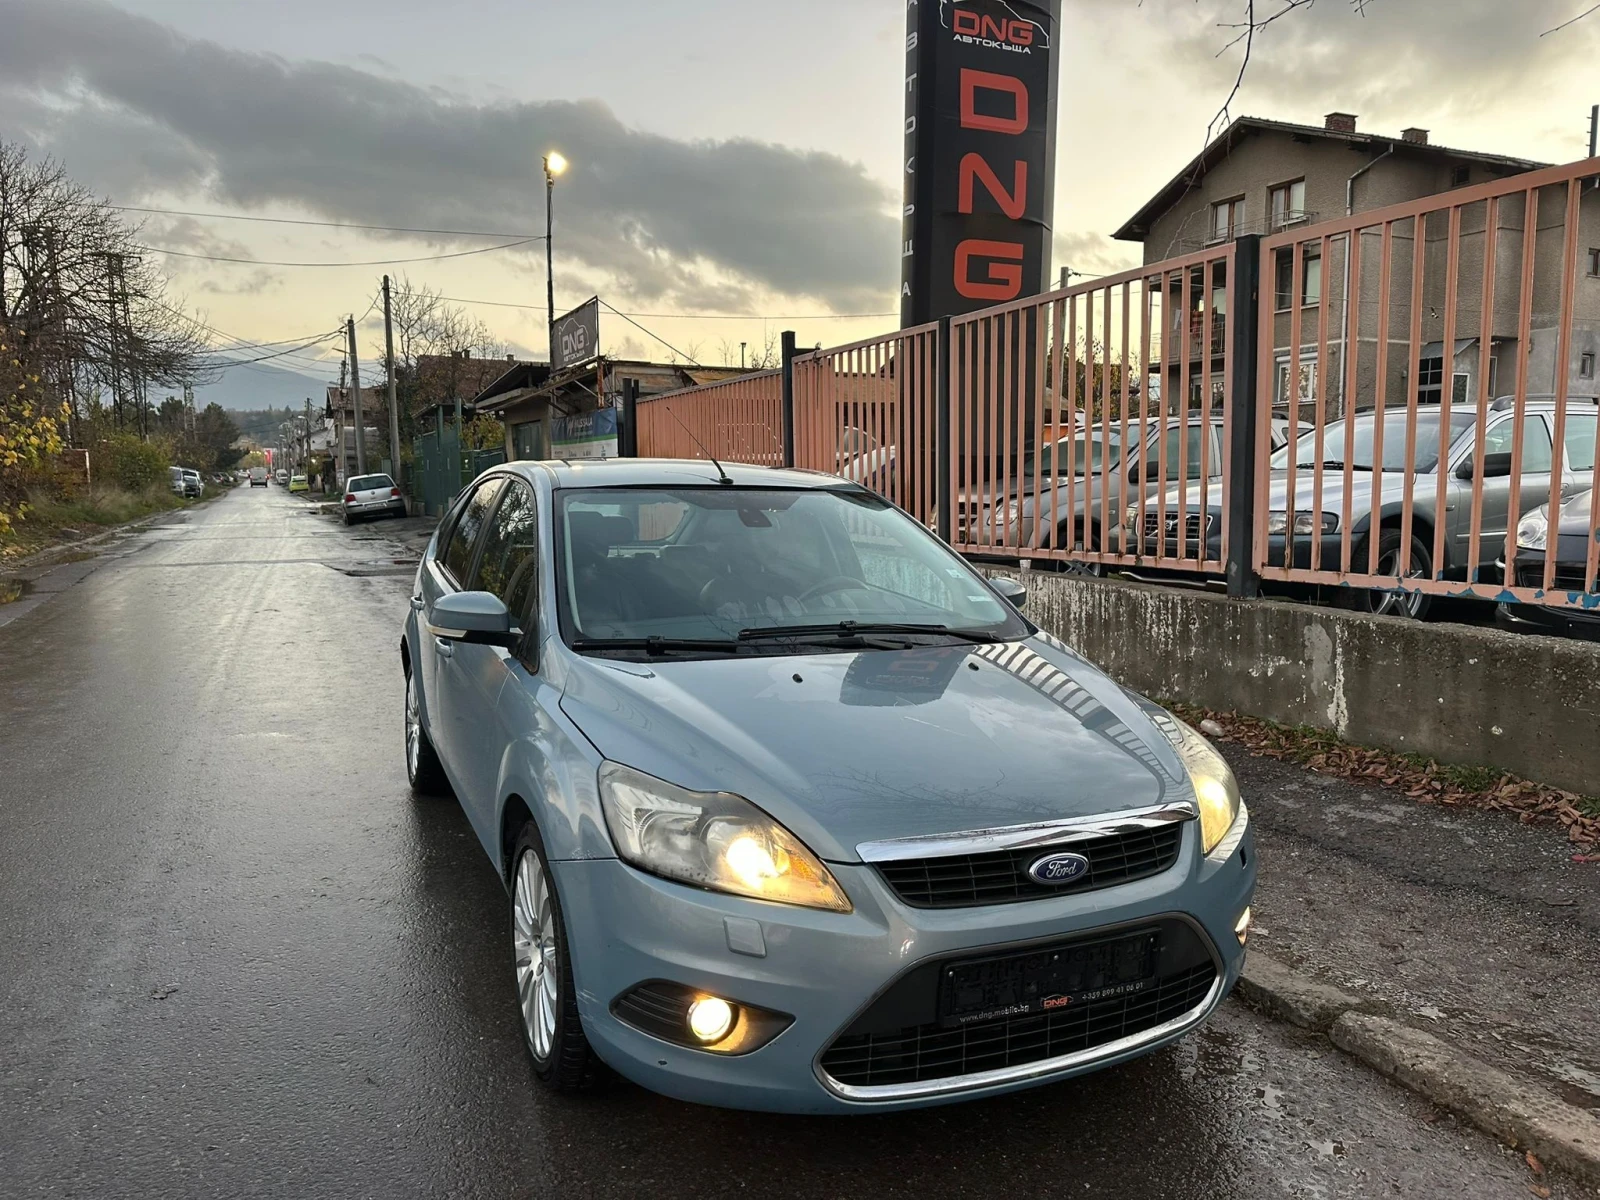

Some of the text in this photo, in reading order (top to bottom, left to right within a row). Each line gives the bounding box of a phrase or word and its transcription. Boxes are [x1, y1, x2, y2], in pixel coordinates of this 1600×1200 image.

[953, 9, 1033, 46] DNG
[953, 34, 1031, 54] АВТОКЪЩА
[953, 67, 1029, 300] DNG
[562, 328, 584, 355] DNG
[1046, 859, 1077, 878] Ford
[1082, 991, 1100, 1000] +359
[1102, 988, 1114, 997] 899
[1116, 985, 1124, 993] 41
[1135, 982, 1143, 990] 01
[1043, 997, 1067, 1007] DNG
[959, 1004, 1030, 1023] www.dng.mobile.bg
